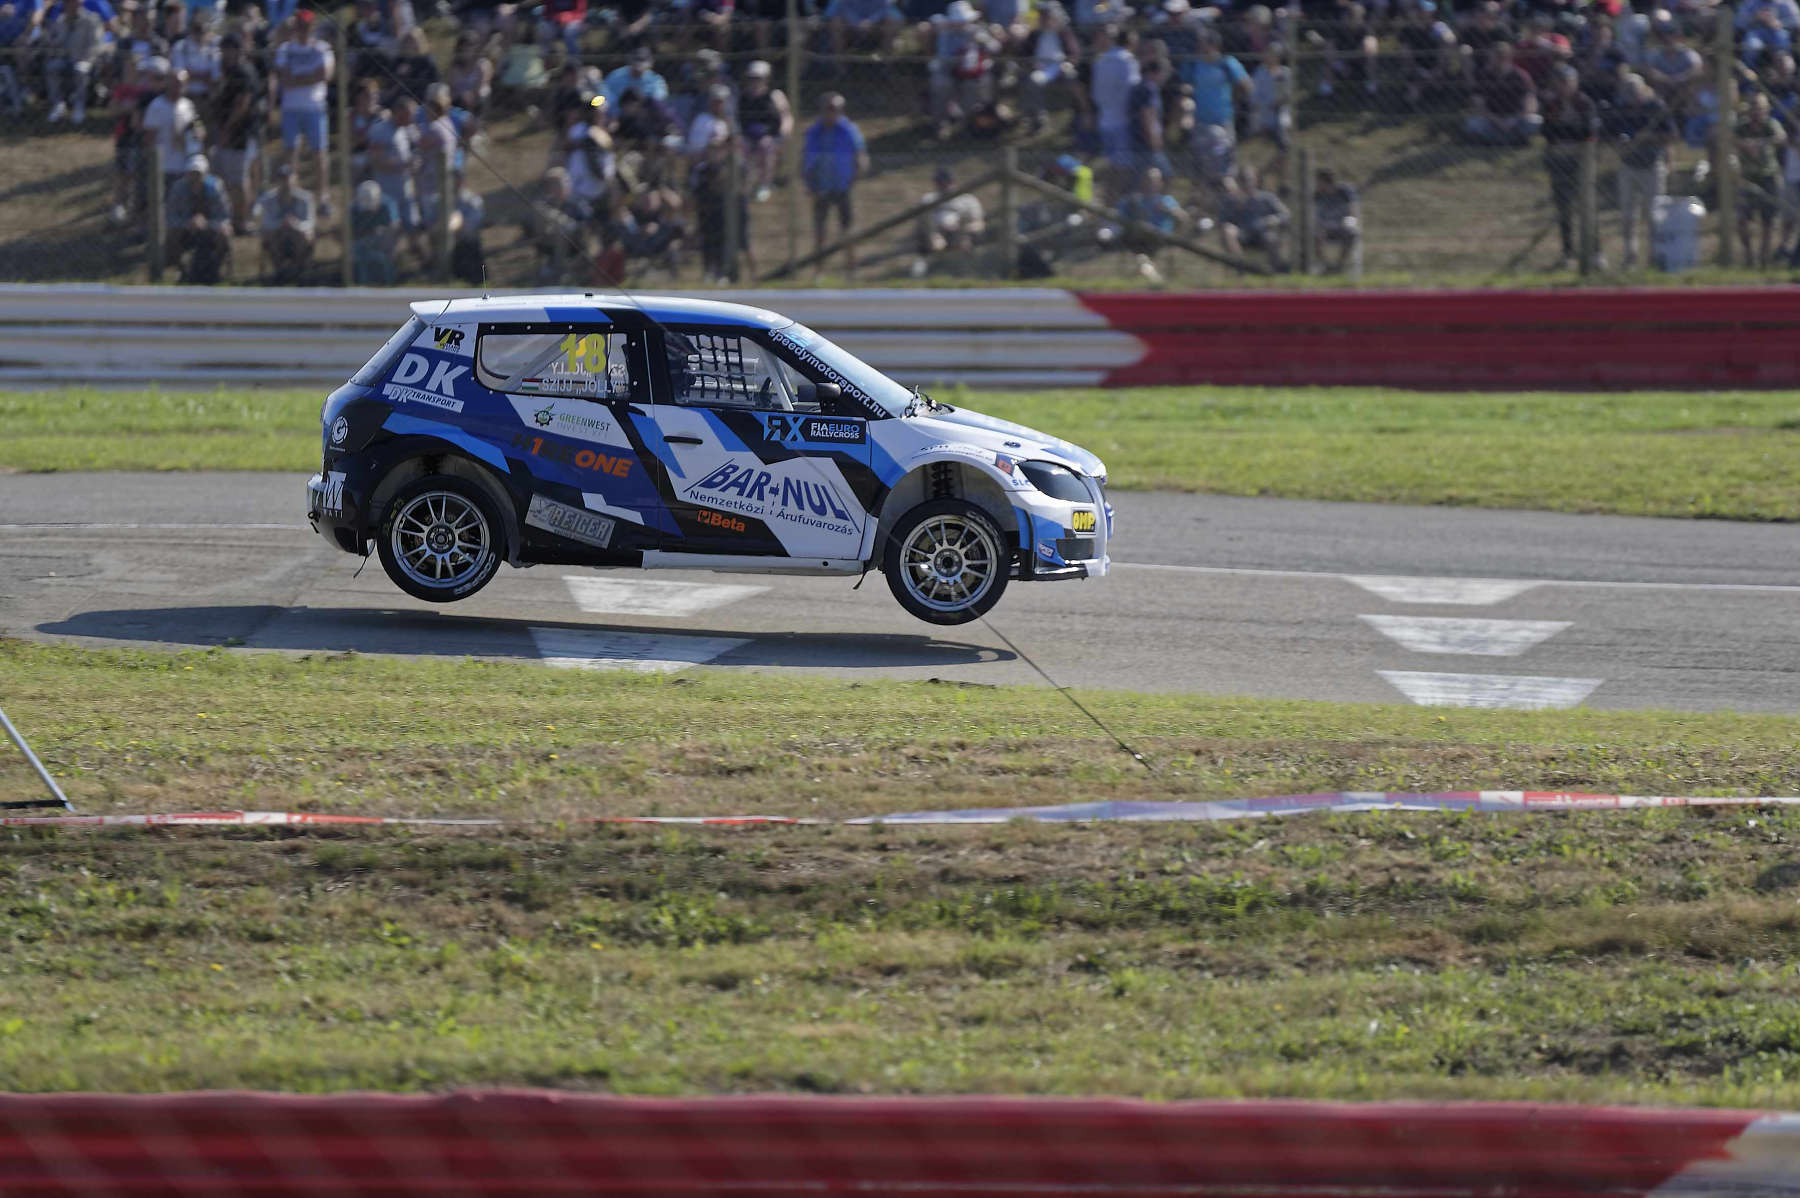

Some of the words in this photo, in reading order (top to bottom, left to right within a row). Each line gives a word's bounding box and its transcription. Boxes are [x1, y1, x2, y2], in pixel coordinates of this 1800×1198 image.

[560, 333, 607, 373] 18
[391, 352, 470, 397] DK
[768, 329, 887, 418] speedymotorsport.hu
[412, 391, 457, 408] TRANSPORT
[559, 413, 611, 431] GREENWEST
[810, 430, 860, 439] RALLYCROSS
[548, 504, 610, 542] REIGER
[690, 490, 764, 515] Nemzetközi
[776, 509, 854, 535] Árufuvarozás
[711, 513, 745, 532] Beta
[1072, 512, 1096, 530] OMP
